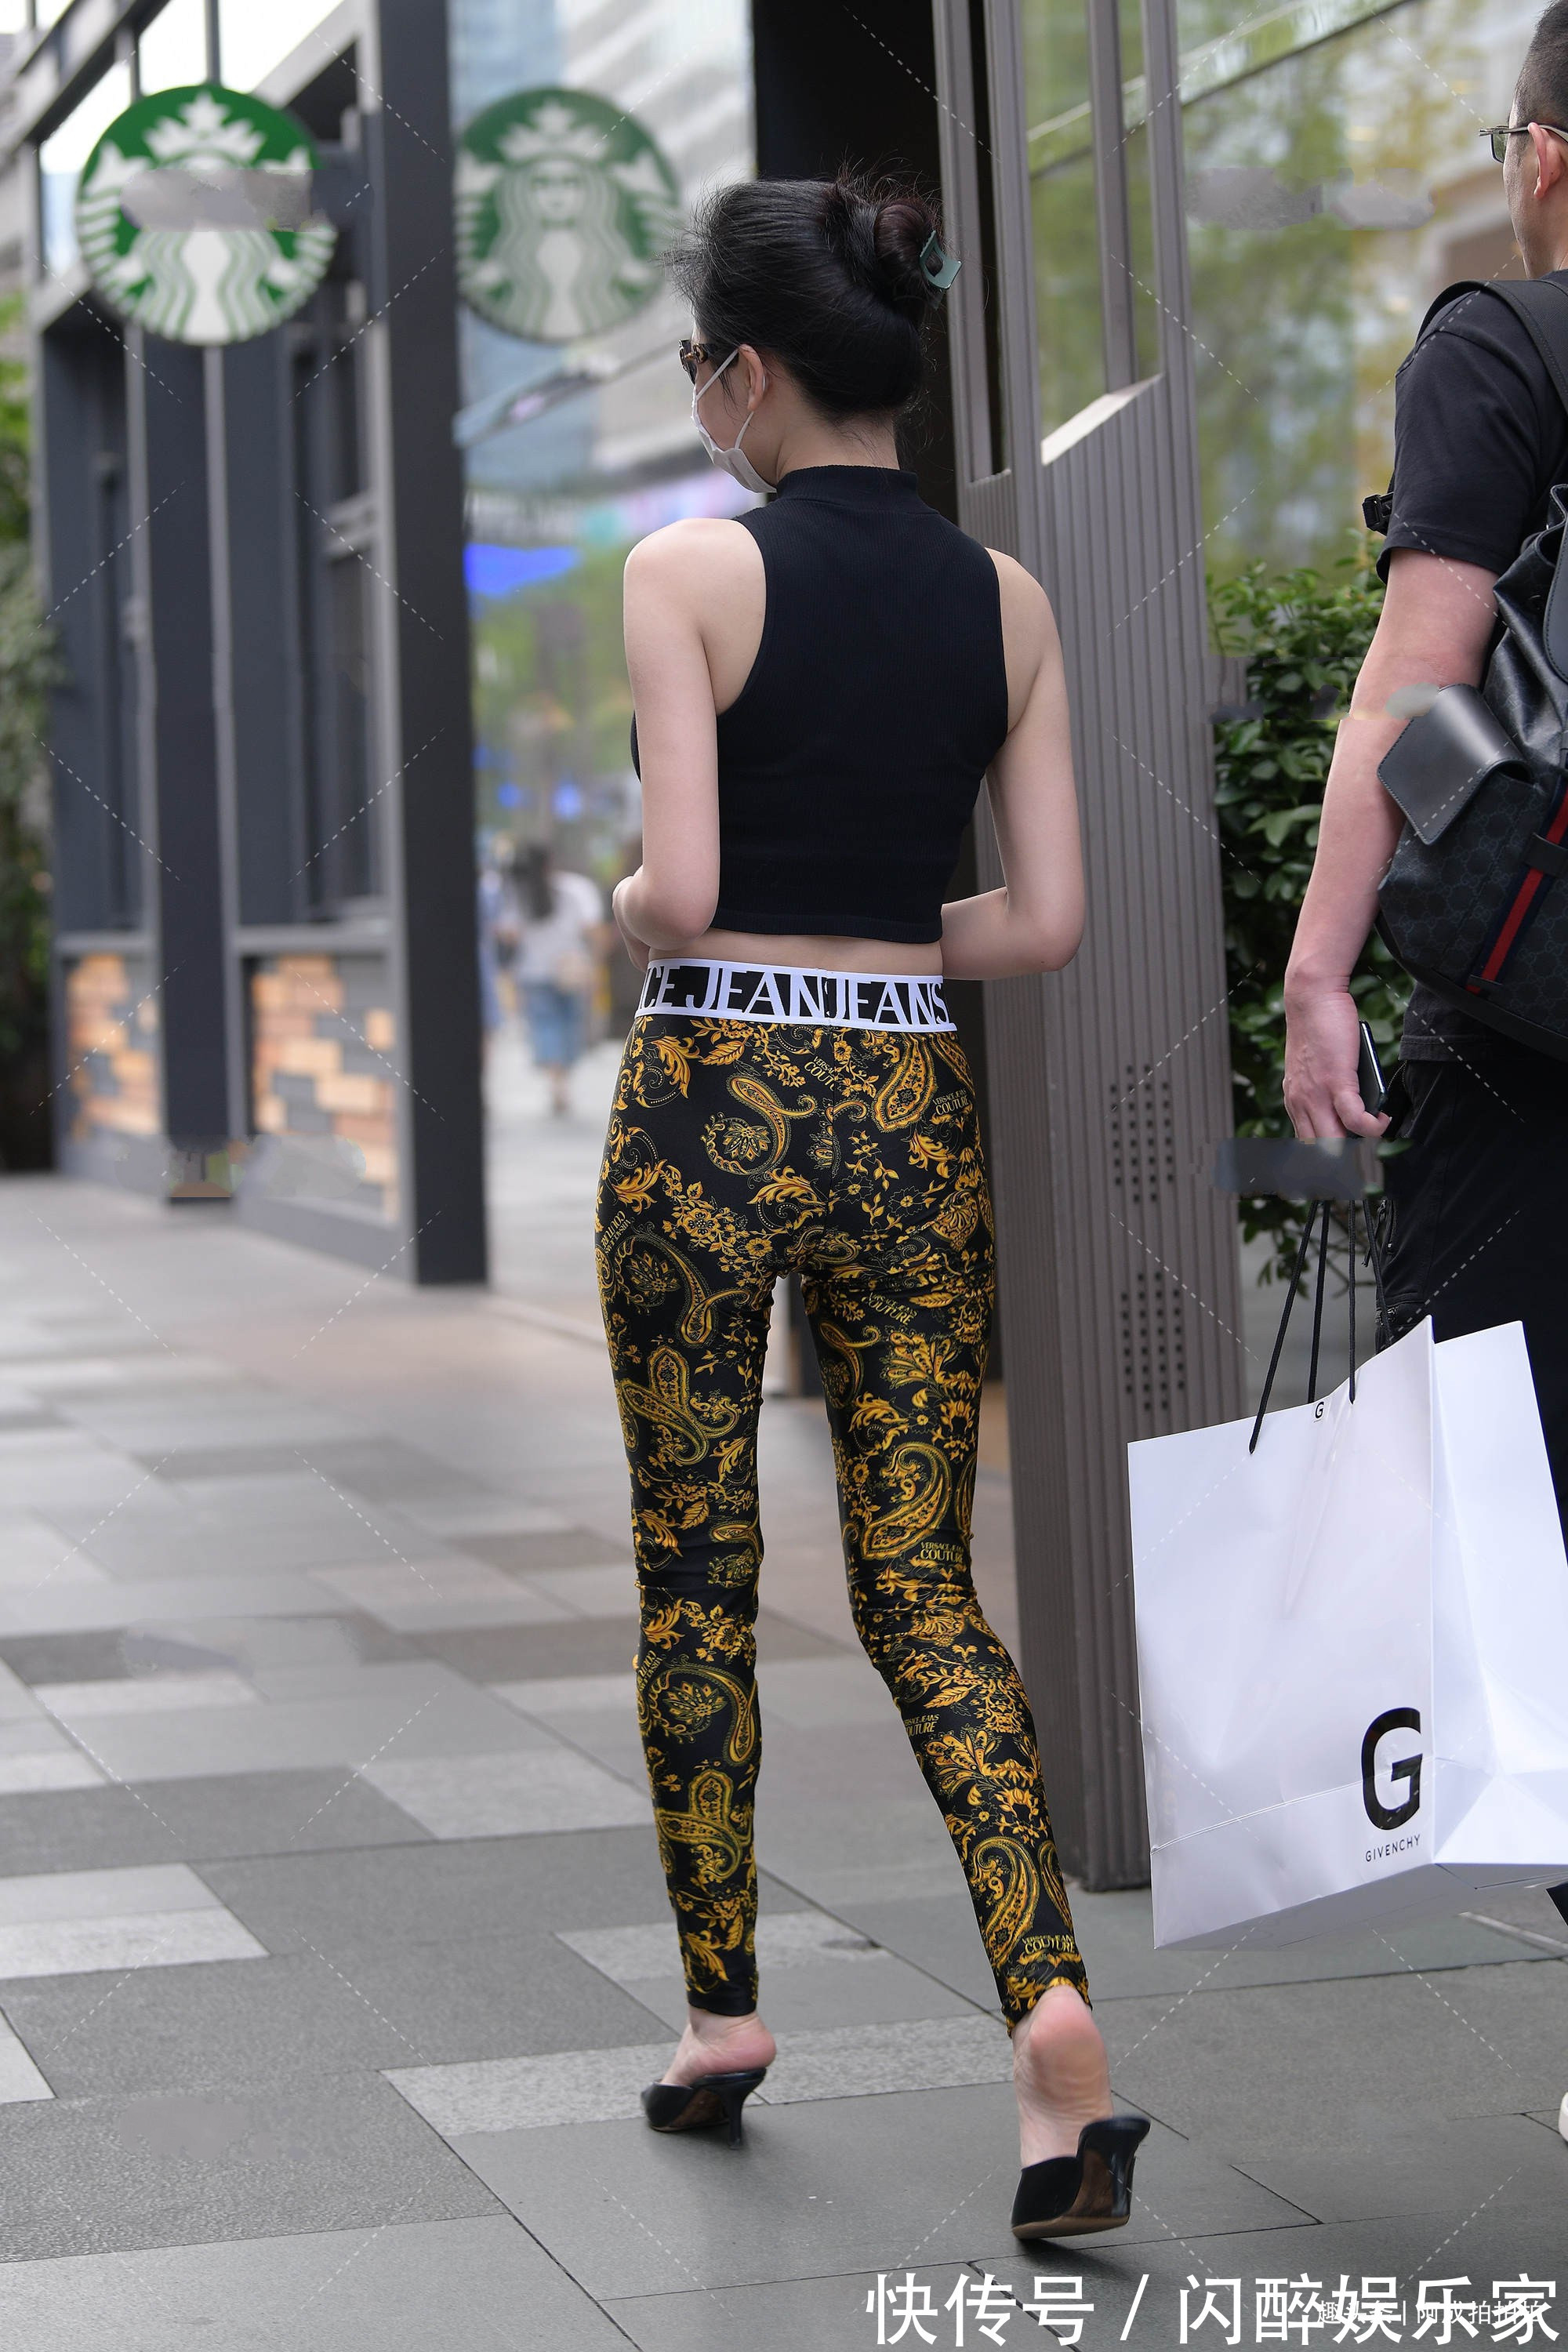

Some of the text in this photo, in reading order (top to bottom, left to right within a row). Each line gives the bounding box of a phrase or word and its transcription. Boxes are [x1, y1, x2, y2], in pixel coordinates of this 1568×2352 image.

[1315, 1401, 1324, 1419] G
[1360, 1707, 1423, 1831] G
[1365, 1834, 1421, 1863] GIVENCHY
